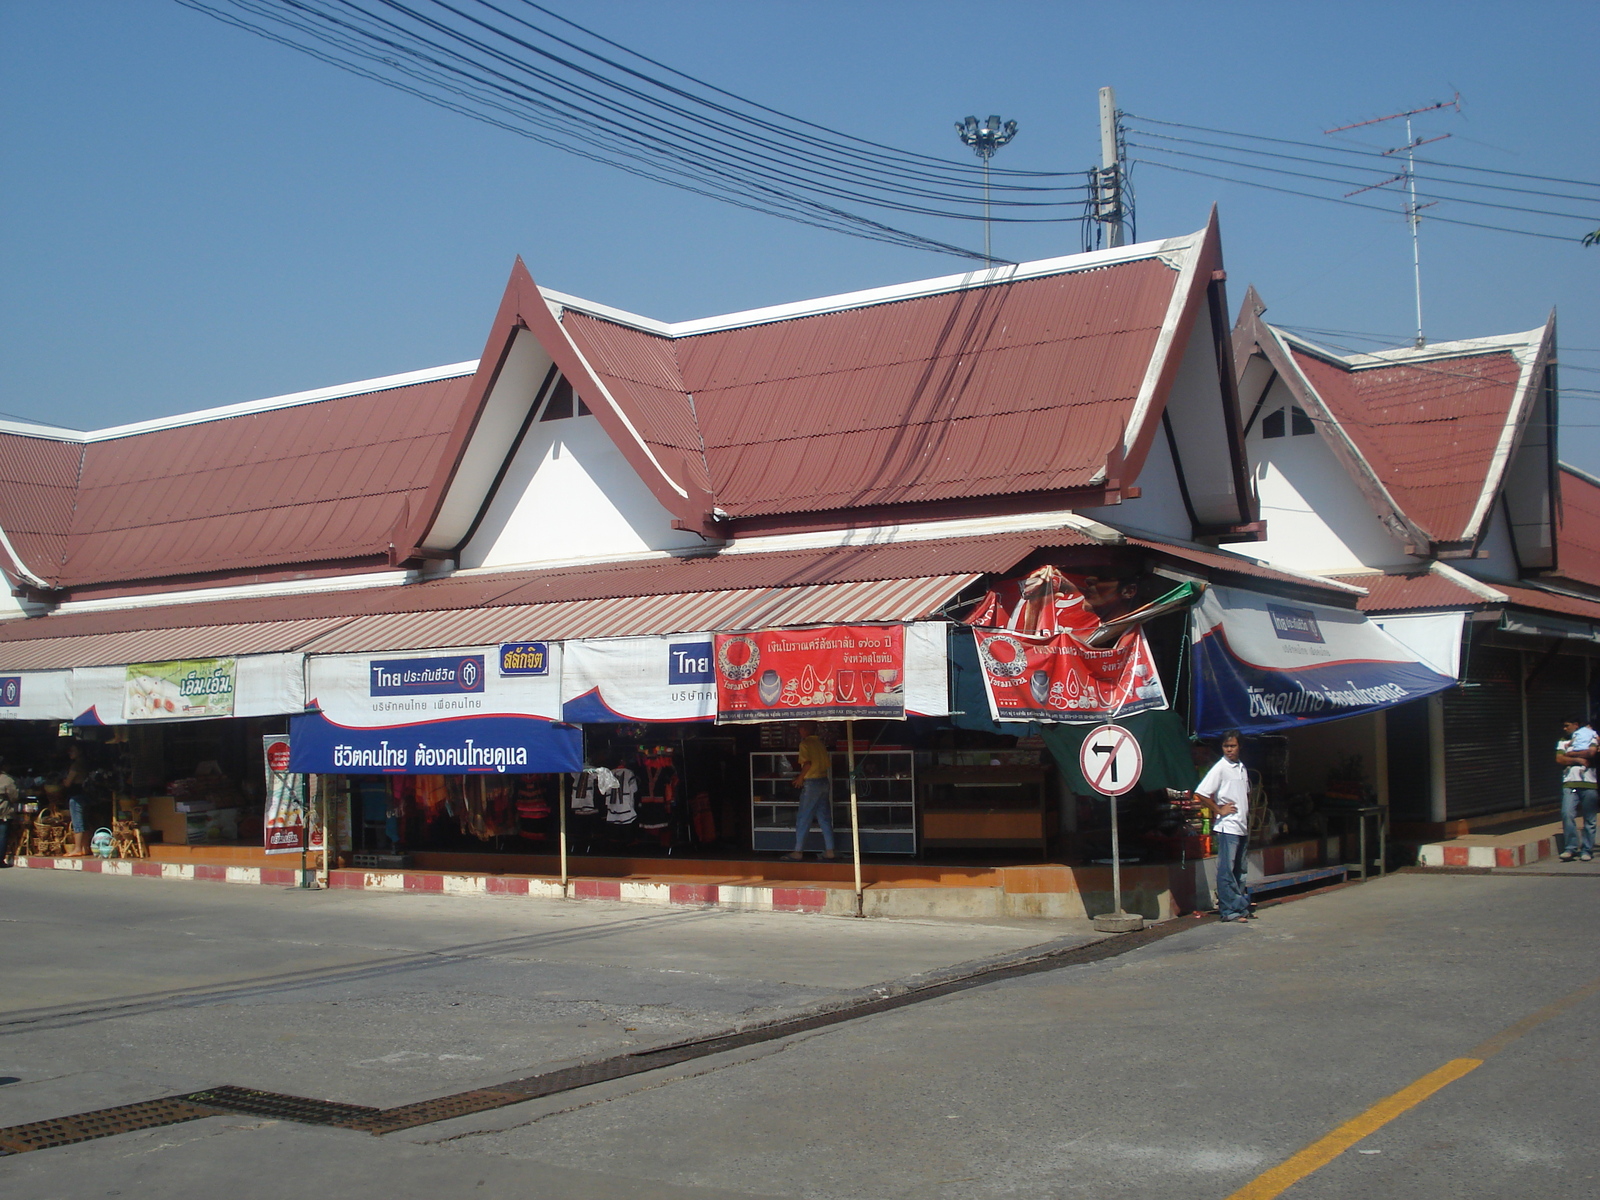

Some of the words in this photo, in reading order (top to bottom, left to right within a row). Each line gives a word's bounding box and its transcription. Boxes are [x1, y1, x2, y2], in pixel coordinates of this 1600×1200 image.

[503, 646, 544, 669] สลักจิต
[672, 651, 709, 674] ไทย
[372, 666, 401, 687] ไทย
[403, 668, 456, 683] ประกันชีวิต
[372, 698, 427, 712] บริษัทคนไทย
[433, 697, 482, 711] เพื่อคนไทย
[1246, 680, 1324, 718] ชีวิตคนไทย
[333, 740, 407, 767] ชีวิตคนไทย
[414, 739, 528, 773] ต้องคนไทยดูแล
